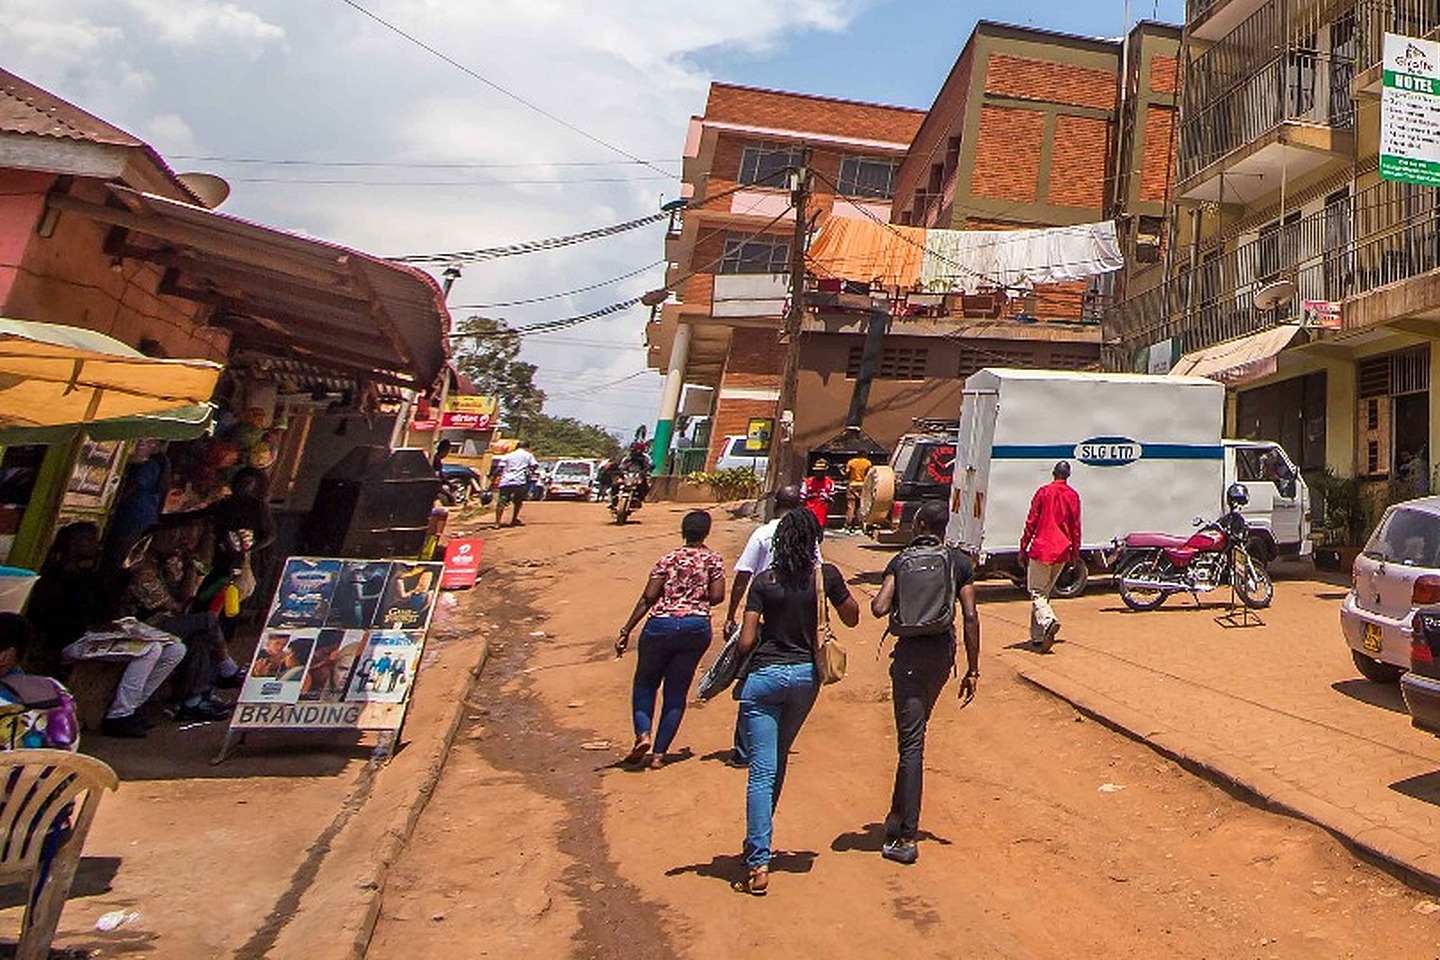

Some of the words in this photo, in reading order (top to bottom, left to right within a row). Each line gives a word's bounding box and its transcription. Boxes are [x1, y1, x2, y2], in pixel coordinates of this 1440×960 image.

[1395, 74, 1434, 94] HOTEL
[1110, 445, 1133, 459] LTD
[238, 705, 358, 725] BRANDING
